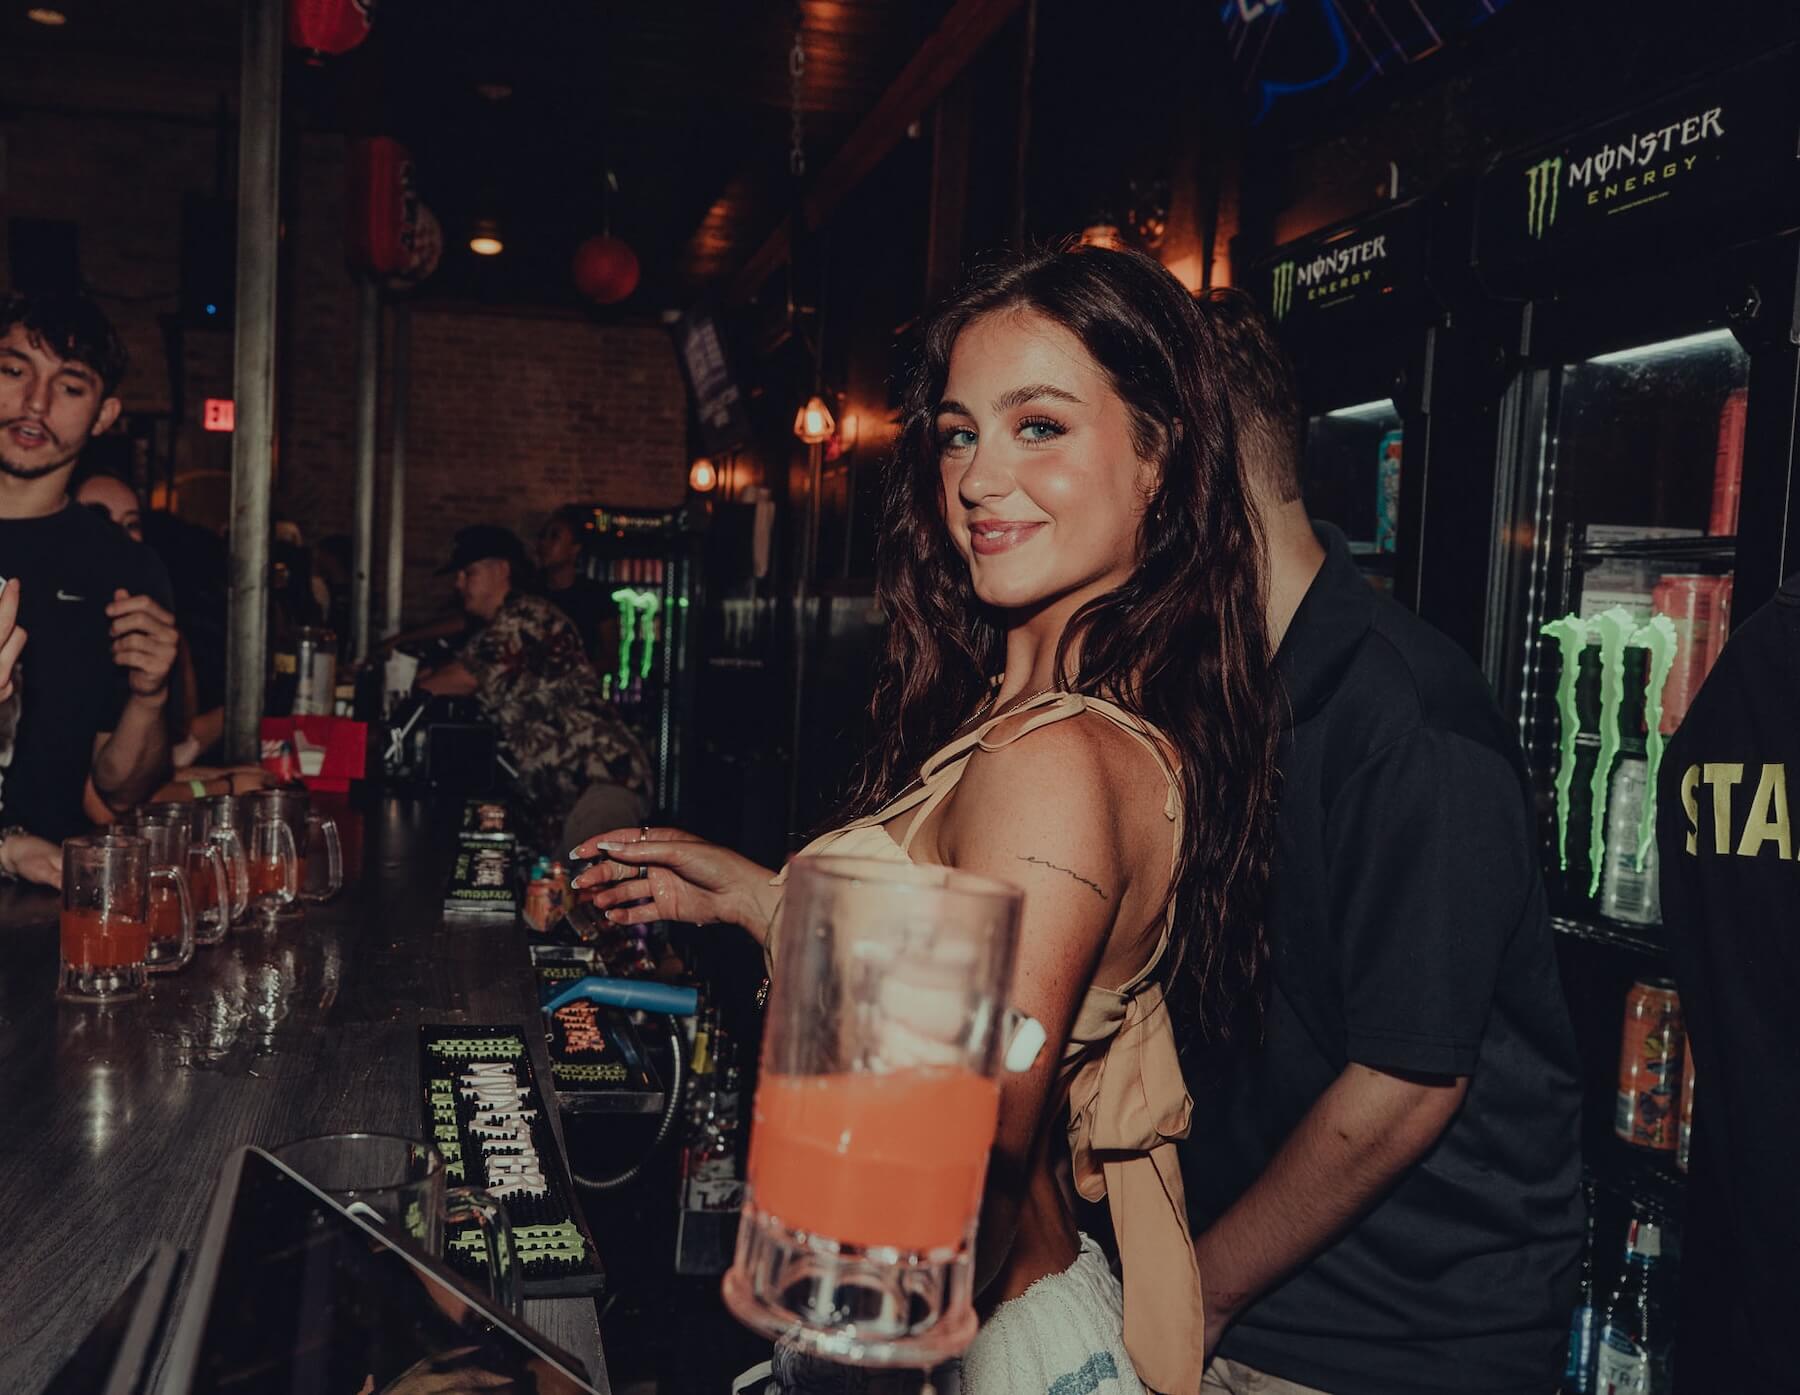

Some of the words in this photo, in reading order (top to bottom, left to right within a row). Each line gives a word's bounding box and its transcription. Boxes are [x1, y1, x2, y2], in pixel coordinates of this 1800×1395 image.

[1568, 107, 1725, 188] MONSTER
[1586, 155, 1697, 206] ENERGY
[1296, 235, 1387, 287] MONSTER
[1308, 270, 1372, 300] ENERGY
[1681, 762, 1800, 861] STA
